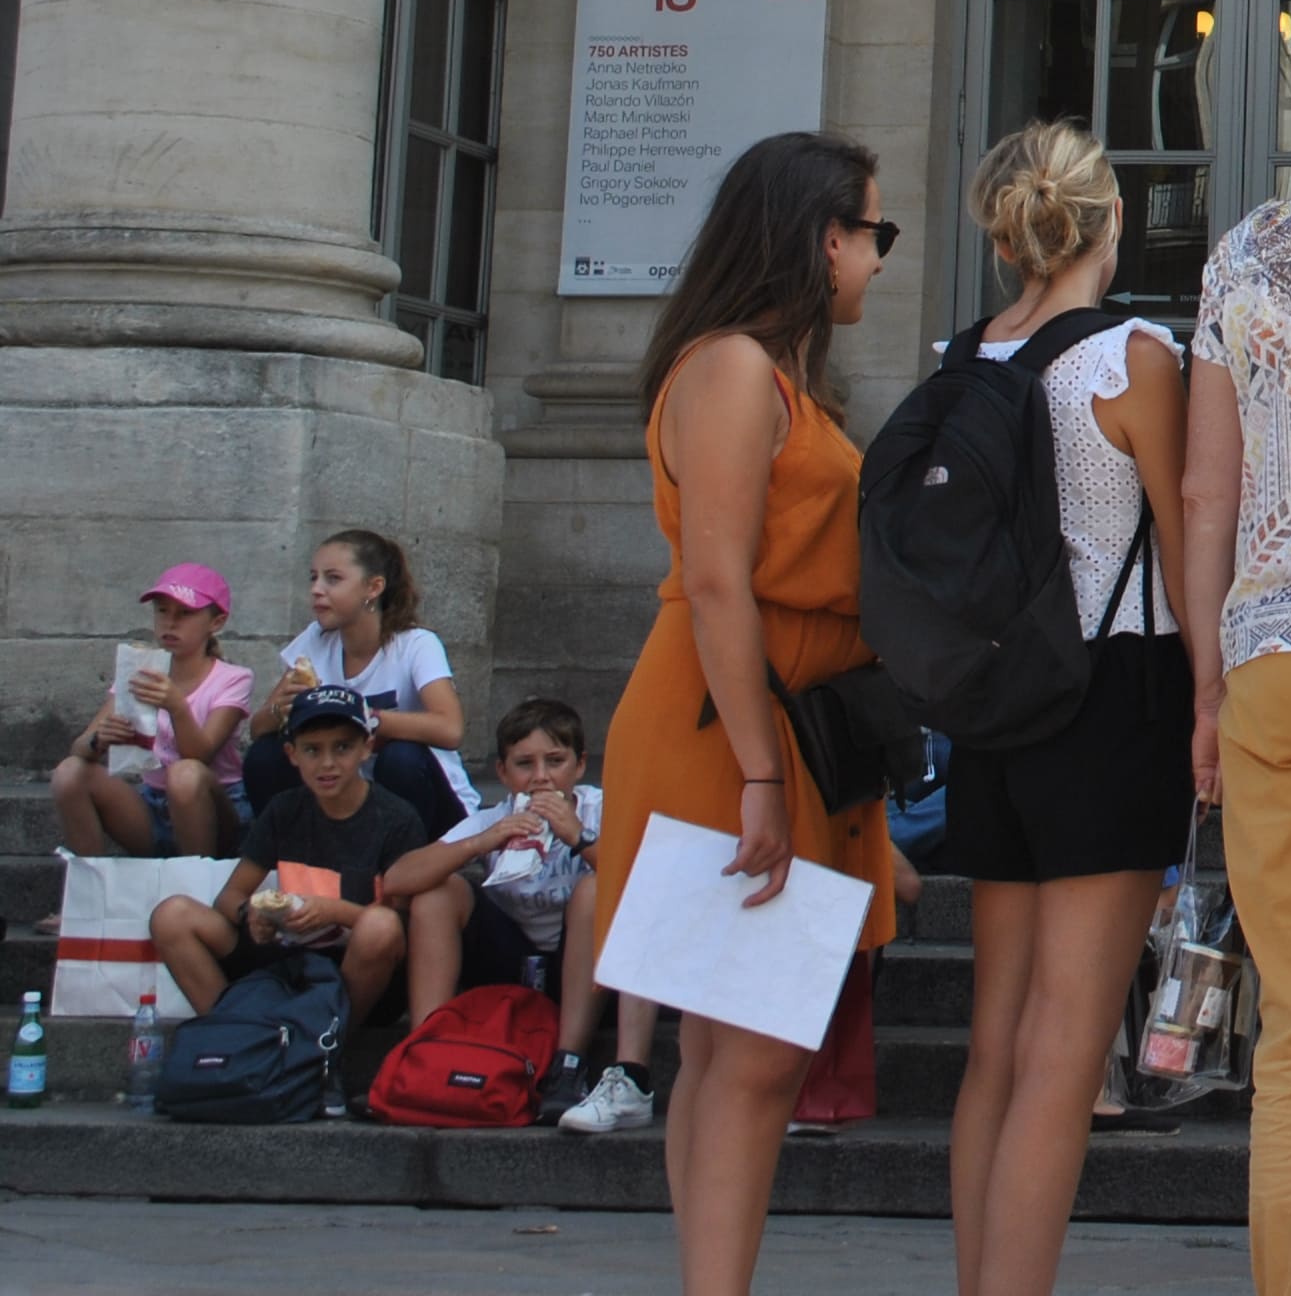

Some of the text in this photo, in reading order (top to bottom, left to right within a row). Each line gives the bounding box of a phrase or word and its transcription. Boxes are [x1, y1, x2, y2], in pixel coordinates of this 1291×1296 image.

[588, 45, 689, 58] 750 ARTISTES
[586, 61, 688, 75] Anna Netrebko
[585, 78, 700, 91] Jonas Kaufmann
[585, 94, 695, 107] Rolando Villazón
[584, 110, 691, 124] Marc Minkowski
[583, 127, 688, 142] Raphael Pichon
[582, 143, 722, 159] Philippe Herreweghe
[581, 159, 656, 173] Paul Daniel
[580, 176, 688, 192] Grigory Sokolov
[579, 192, 675, 209] Ivo Pogorelich
